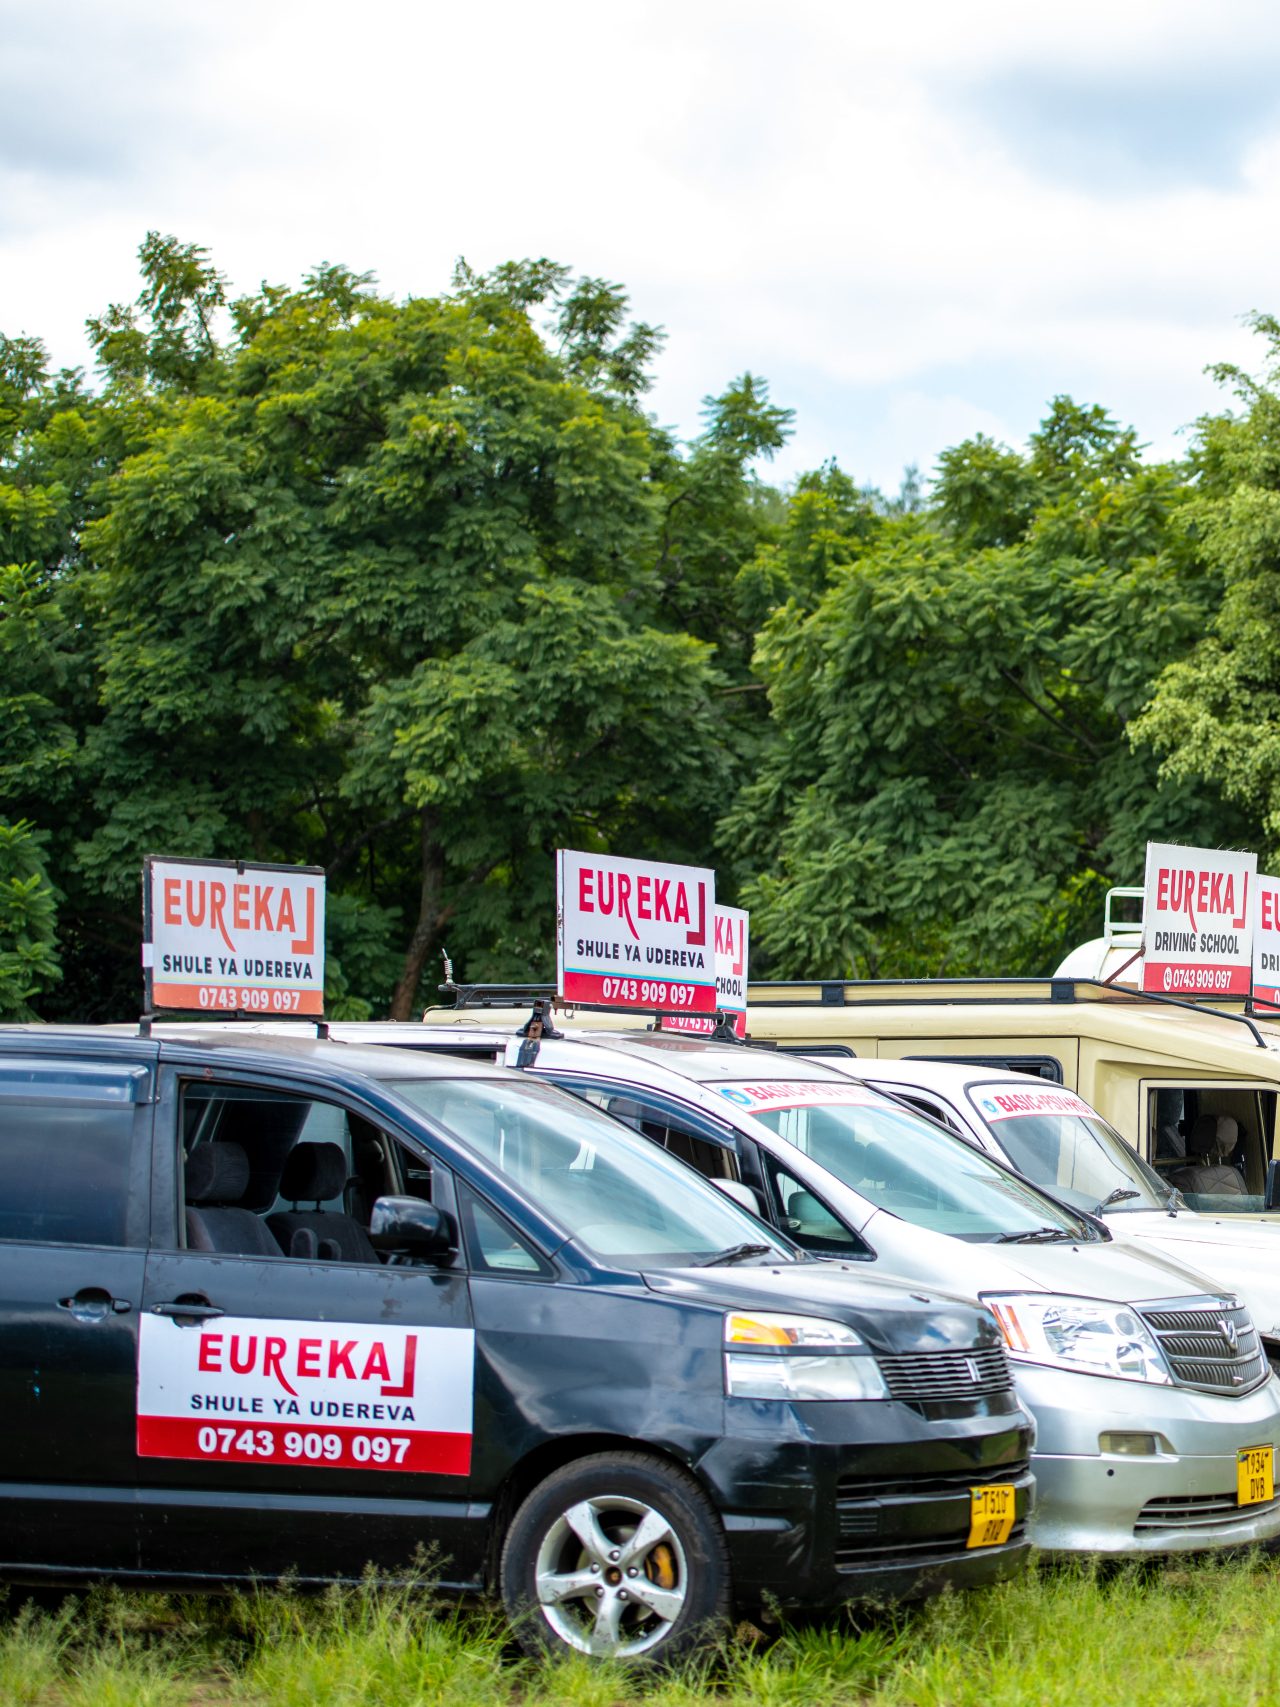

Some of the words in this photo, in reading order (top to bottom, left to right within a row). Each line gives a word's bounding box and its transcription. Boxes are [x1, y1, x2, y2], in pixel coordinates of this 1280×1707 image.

[579, 867, 691, 941] EUREKA
[1157, 868, 1235, 934] EUREKA
[164, 878, 296, 952] EUREKA
[577, 939, 619, 960] SHULE
[625, 944, 641, 962] YA
[647, 947, 705, 969] UDEREVA
[1155, 931, 1197, 953] DRIVING
[1200, 933, 1239, 955] SCHOOL
[163, 954, 213, 975] SHULE
[218, 957, 238, 976] YA
[244, 959, 313, 980] UDEREVA
[1173, 969, 1195, 988] 0743
[1196, 970, 1215, 988] 909
[1215, 971, 1232, 989] 097
[199, 987, 237, 1008] 0743
[241, 990, 269, 1010] 909
[273, 991, 301, 1011] 097
[603, 978, 637, 1001] 0743
[641, 980, 667, 1003] 909
[670, 984, 696, 1006] 097
[715, 976, 742, 997] CHOOL
[198, 1333, 391, 1397] EUREKA
[190, 1394, 263, 1413] SHULE
[273, 1398, 300, 1415] YA
[310, 1401, 415, 1421] UDEREVA
[198, 1427, 274, 1456] 0743
[284, 1432, 342, 1460] 909
[352, 1436, 411, 1463] 097
[1246, 1452, 1265, 1475] T934
[983, 1490, 1008, 1515] T510
